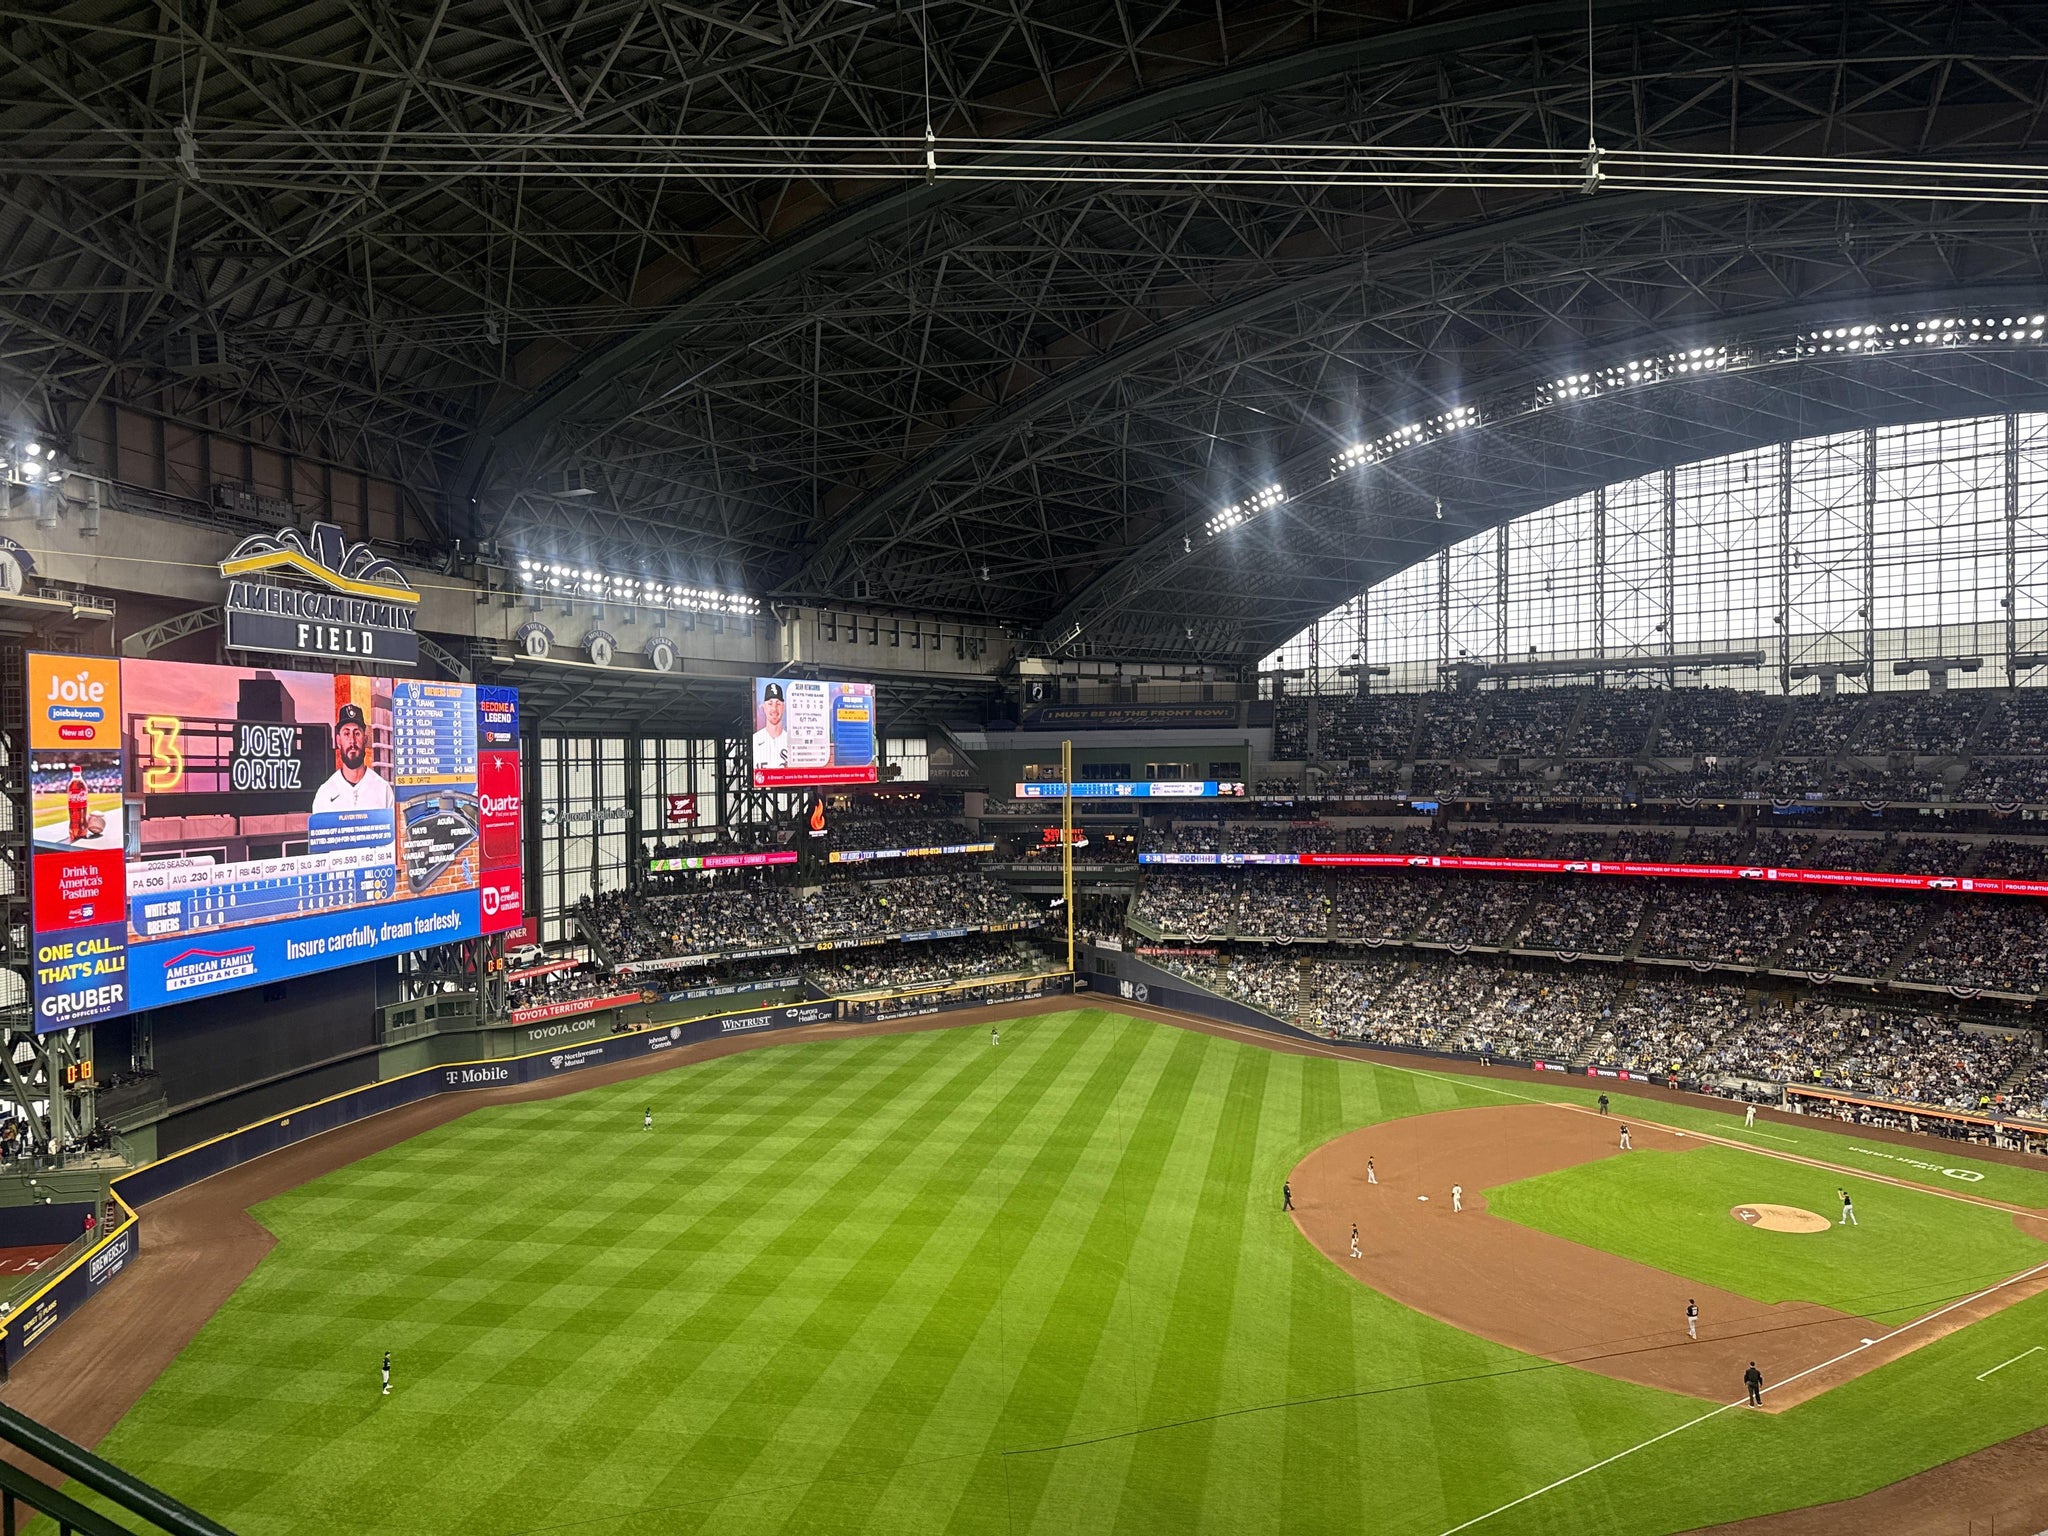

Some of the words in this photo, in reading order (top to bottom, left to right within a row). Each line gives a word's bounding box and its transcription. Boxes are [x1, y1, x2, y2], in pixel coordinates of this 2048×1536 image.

[227, 582, 344, 623] AMERICAN
[350, 599, 416, 632] FAMILY
[297, 624, 373, 654] FIELD
[530, 637, 546, 654] 19
[48, 671, 104, 702] Joie
[481, 701, 509, 712] BECOME
[510, 703, 515, 712] A
[53, 709, 100, 718] joiebaby.com
[485, 712, 511, 723] LEGEND
[240, 725, 295, 757] JOEY
[146, 716, 182, 789] 3
[233, 758, 302, 790] ORTIZ
[480, 794, 518, 816] Quartz
[616, 807, 634, 818] Care
[437, 817, 454, 825] ACUÑA
[412, 827, 427, 835] HAYS
[404, 839, 434, 848] MONTGOMERY
[344, 856, 357, 864] .593
[403, 852, 425, 860] VARGAS
[428, 854, 455, 864] MURAKAMI
[706, 856, 742, 866] REFRESHINGLY
[744, 855, 766, 864] SUMMER
[1220, 854, 1234, 863] 82
[148, 862, 166, 871] 2025
[167, 859, 194, 869] SEASON
[280, 863, 294, 872] .276
[314, 859, 326, 868] .317
[62, 866, 88, 878] Drink
[90, 865, 98, 875] in
[227, 870, 232, 878] 7
[251, 867, 260, 875] 45
[409, 868, 427, 877] QUERO
[58, 876, 103, 889] America's
[146, 877, 164, 887] 506
[172, 875, 187, 884] AVG
[190, 872, 207, 882] .230
[62, 887, 99, 900] Pastime
[500, 892, 519, 902] credit
[144, 902, 167, 918] WHITE
[168, 901, 181, 914] SOX
[194, 899, 199, 912] 1
[206, 898, 211, 910] 0
[218, 896, 224, 908] 0
[230, 894, 236, 906] 0
[500, 901, 520, 911] union
[147, 918, 180, 935] BREWERS
[194, 915, 199, 928] 0
[206, 914, 212, 926] 4
[218, 912, 224, 923] 0
[348, 893, 353, 903] 2
[287, 939, 325, 960] Insure
[328, 925, 379, 952] carefully,
[380, 922, 412, 941] dream
[414, 909, 462, 931] fearlessly.
[38, 943, 74, 963] ONE
[76, 938, 124, 956] CALL...
[817, 942, 833, 950] 620
[834, 939, 859, 949] WTMJ
[38, 962, 92, 985] THAT'S
[94, 956, 125, 976] ALL!
[167, 960, 218, 979] AMERICAN
[221, 953, 254, 968] FAMILY
[174, 967, 247, 987] INSURANCE
[755, 982, 773, 990] WELCOME
[687, 990, 707, 998] WELCOME
[715, 987, 734, 995] DELICIOUS
[41, 984, 124, 1016] GRUBER
[72, 1009, 98, 1019] OFFICES
[514, 1009, 548, 1022] TOYOTA
[551, 1000, 594, 1014] TERRITORY
[722, 1016, 769, 1029] WINTRUST
[798, 1013, 818, 1022] Health
[528, 1019, 596, 1041] TOYOTA.COM
[648, 1035, 668, 1045] Johnson
[652, 1040, 672, 1050] Controls
[564, 1047, 604, 1061] Northwestern
[564, 1057, 585, 1067] Mutual
[67, 1060, 92, 1084] 0:18
[462, 1067, 508, 1084] Mobile
[1848, 1146, 1894, 1159] union
[1896, 1157, 1944, 1170] credit
[92, 1240, 126, 1276] BREWERS.TV
[42, 1300, 57, 1316] PLANS
